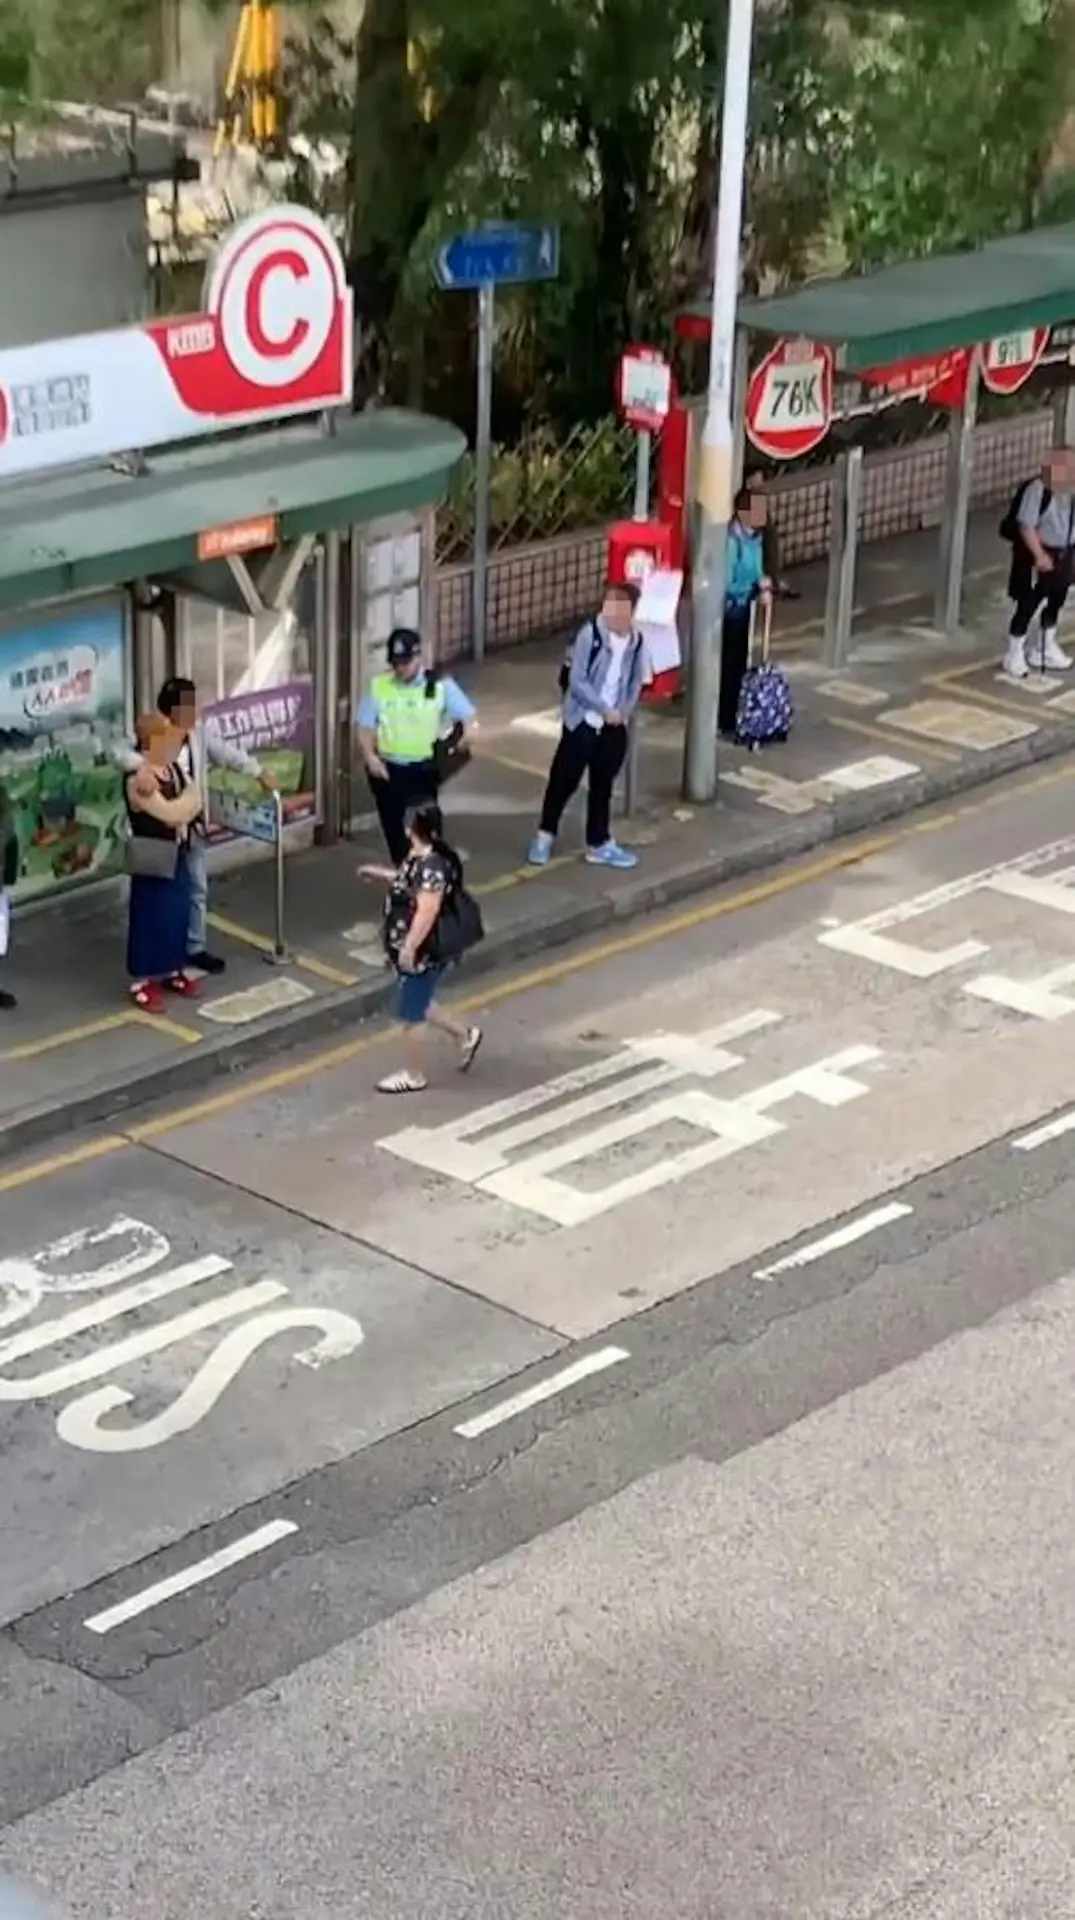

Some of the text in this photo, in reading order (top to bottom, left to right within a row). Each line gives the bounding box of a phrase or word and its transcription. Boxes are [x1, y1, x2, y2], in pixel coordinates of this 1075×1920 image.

[247, 249, 308, 356] C
[771, 375, 820, 418] 76K
[375, 1008, 884, 1227] 站
[0, 1214, 365, 1453] BUS
